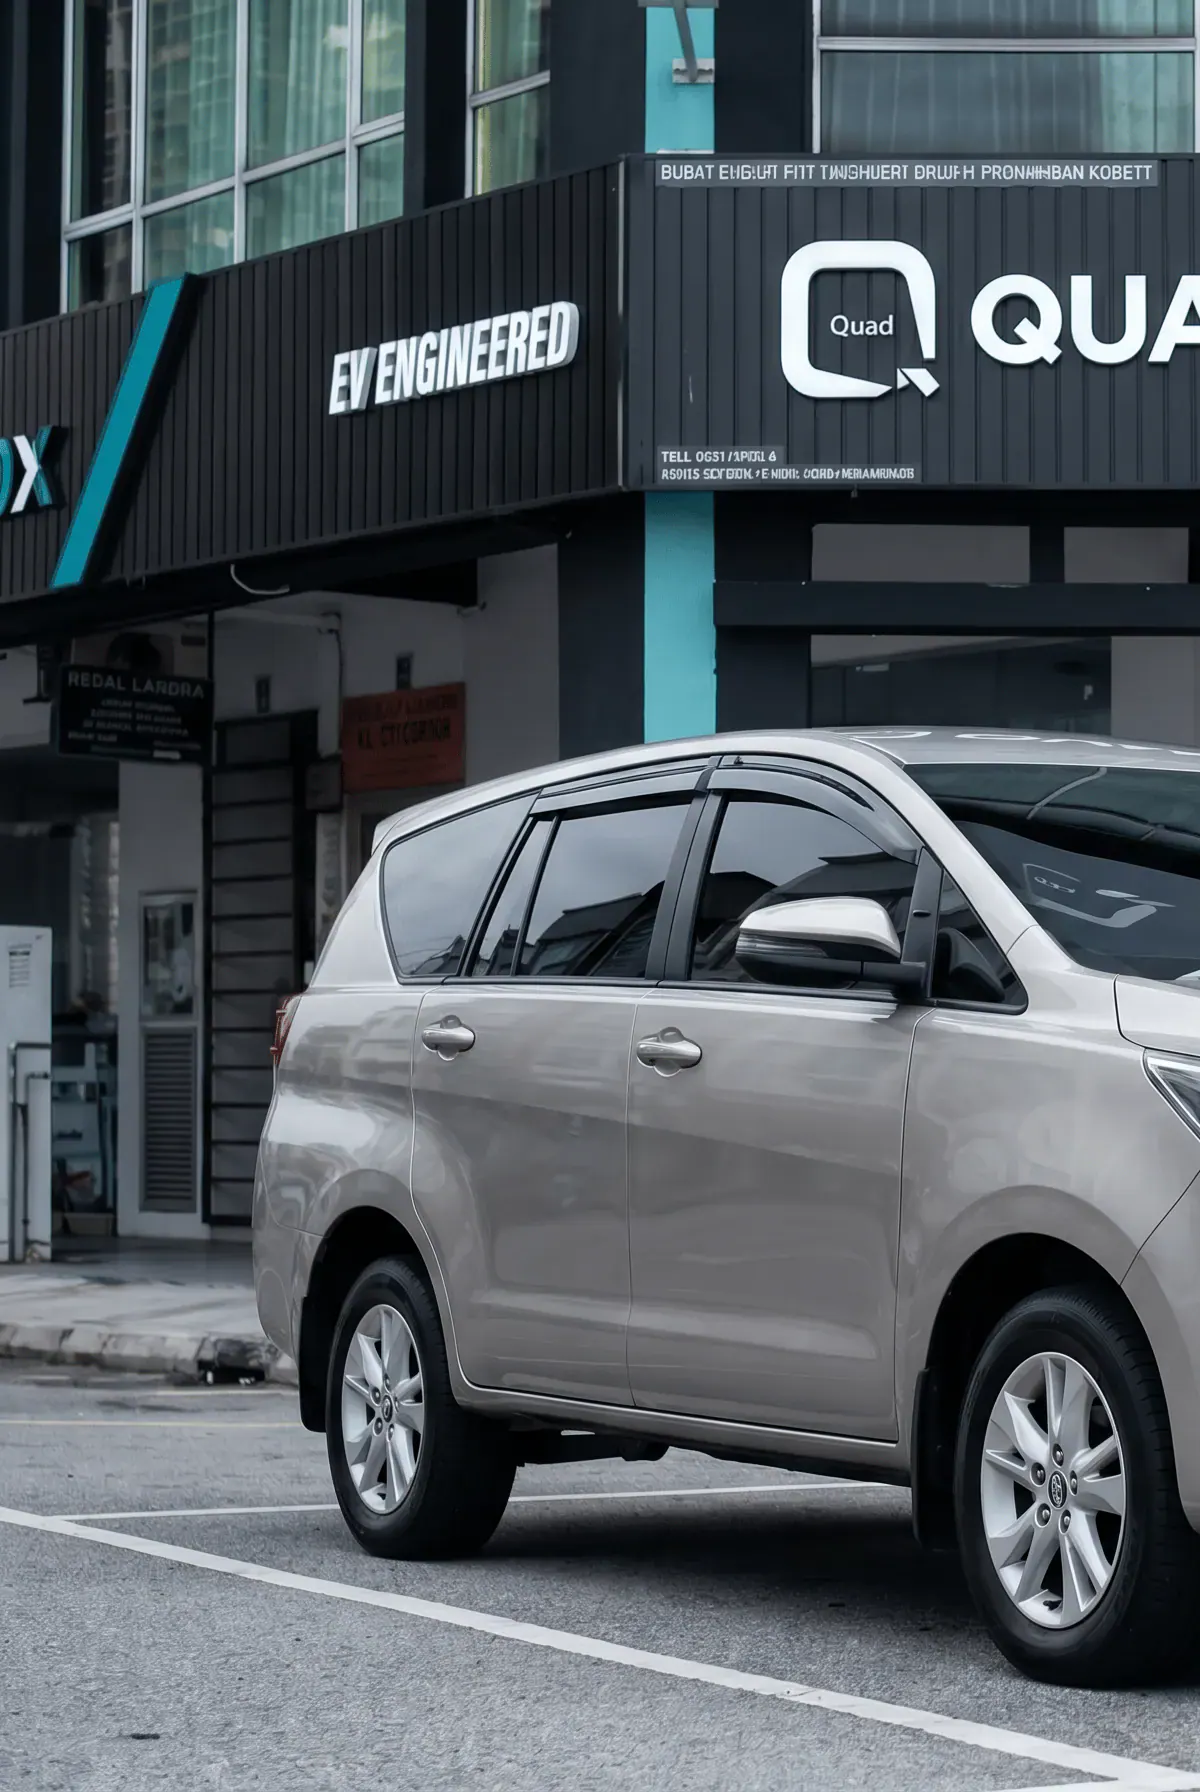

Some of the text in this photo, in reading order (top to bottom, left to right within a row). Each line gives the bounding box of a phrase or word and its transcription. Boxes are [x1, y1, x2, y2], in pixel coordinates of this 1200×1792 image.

[661, 164, 715, 180] BUBAT
[1089, 164, 1153, 180] KOBETT
[829, 313, 894, 338] Quad
[328, 300, 581, 416] EV ENGINEERED
[661, 451, 692, 463] TELL
